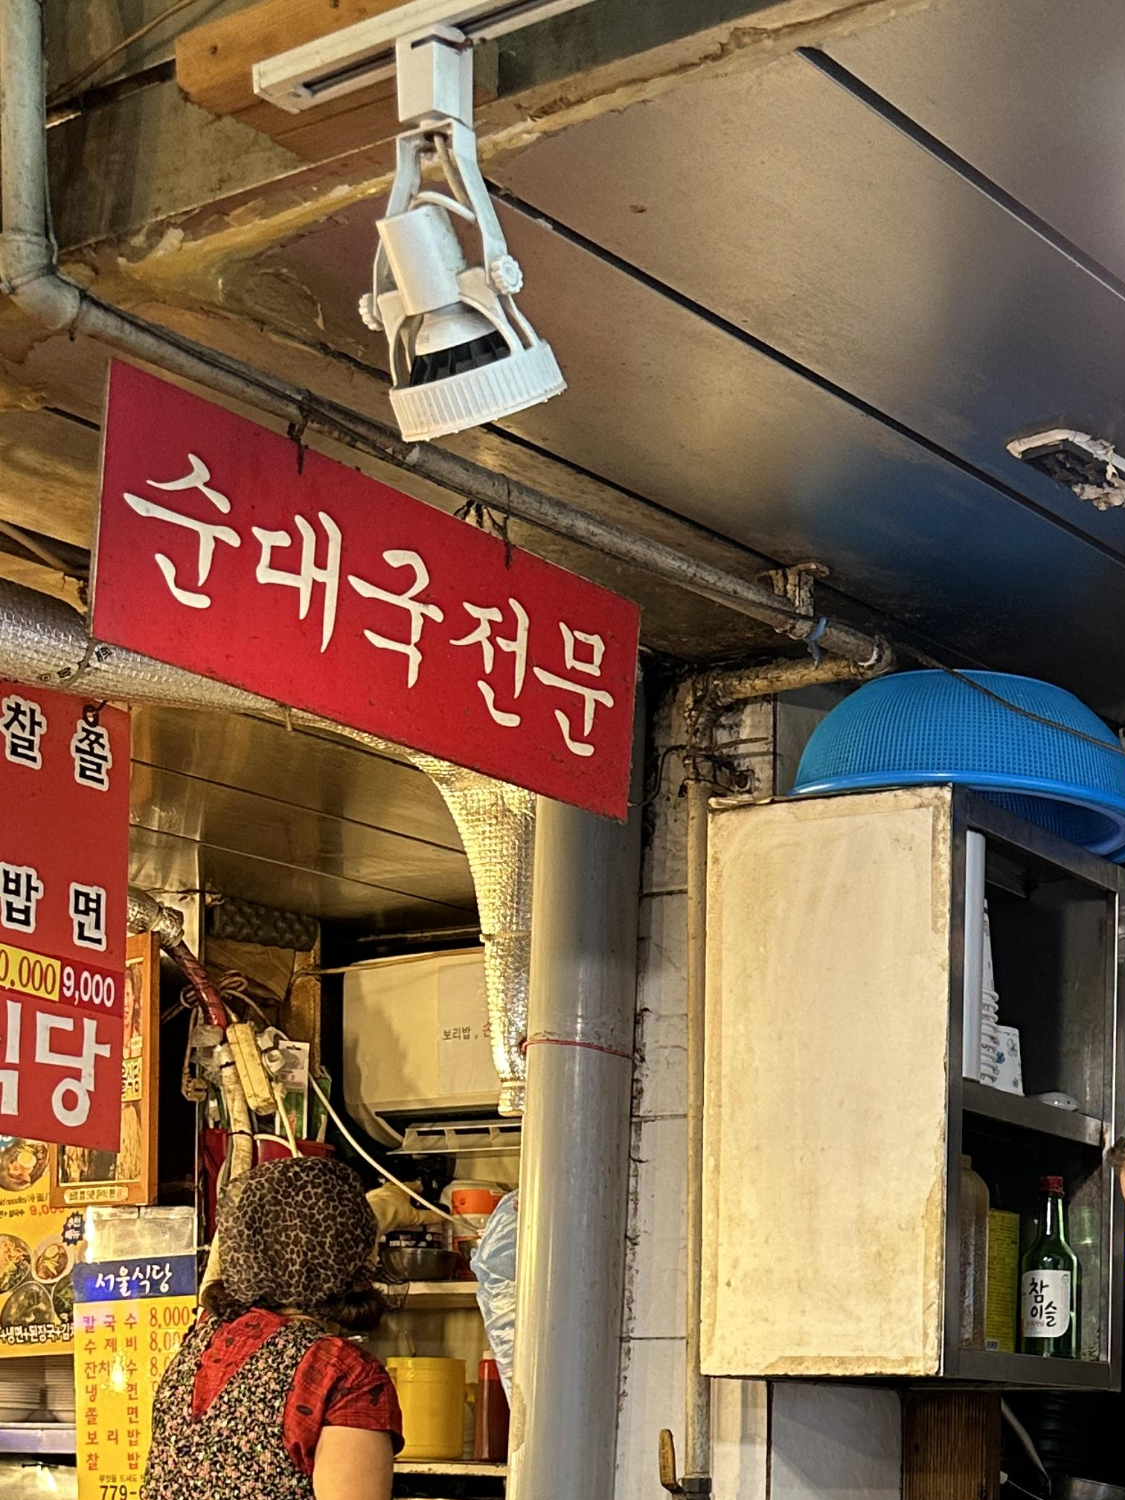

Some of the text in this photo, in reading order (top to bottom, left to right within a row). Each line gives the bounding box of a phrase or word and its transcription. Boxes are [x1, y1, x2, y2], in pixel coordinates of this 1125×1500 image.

[123, 452, 615, 757] 순대국전문
[62, 966, 115, 1007] 9,000
[95, 1263, 173, 1297] 서울식당
